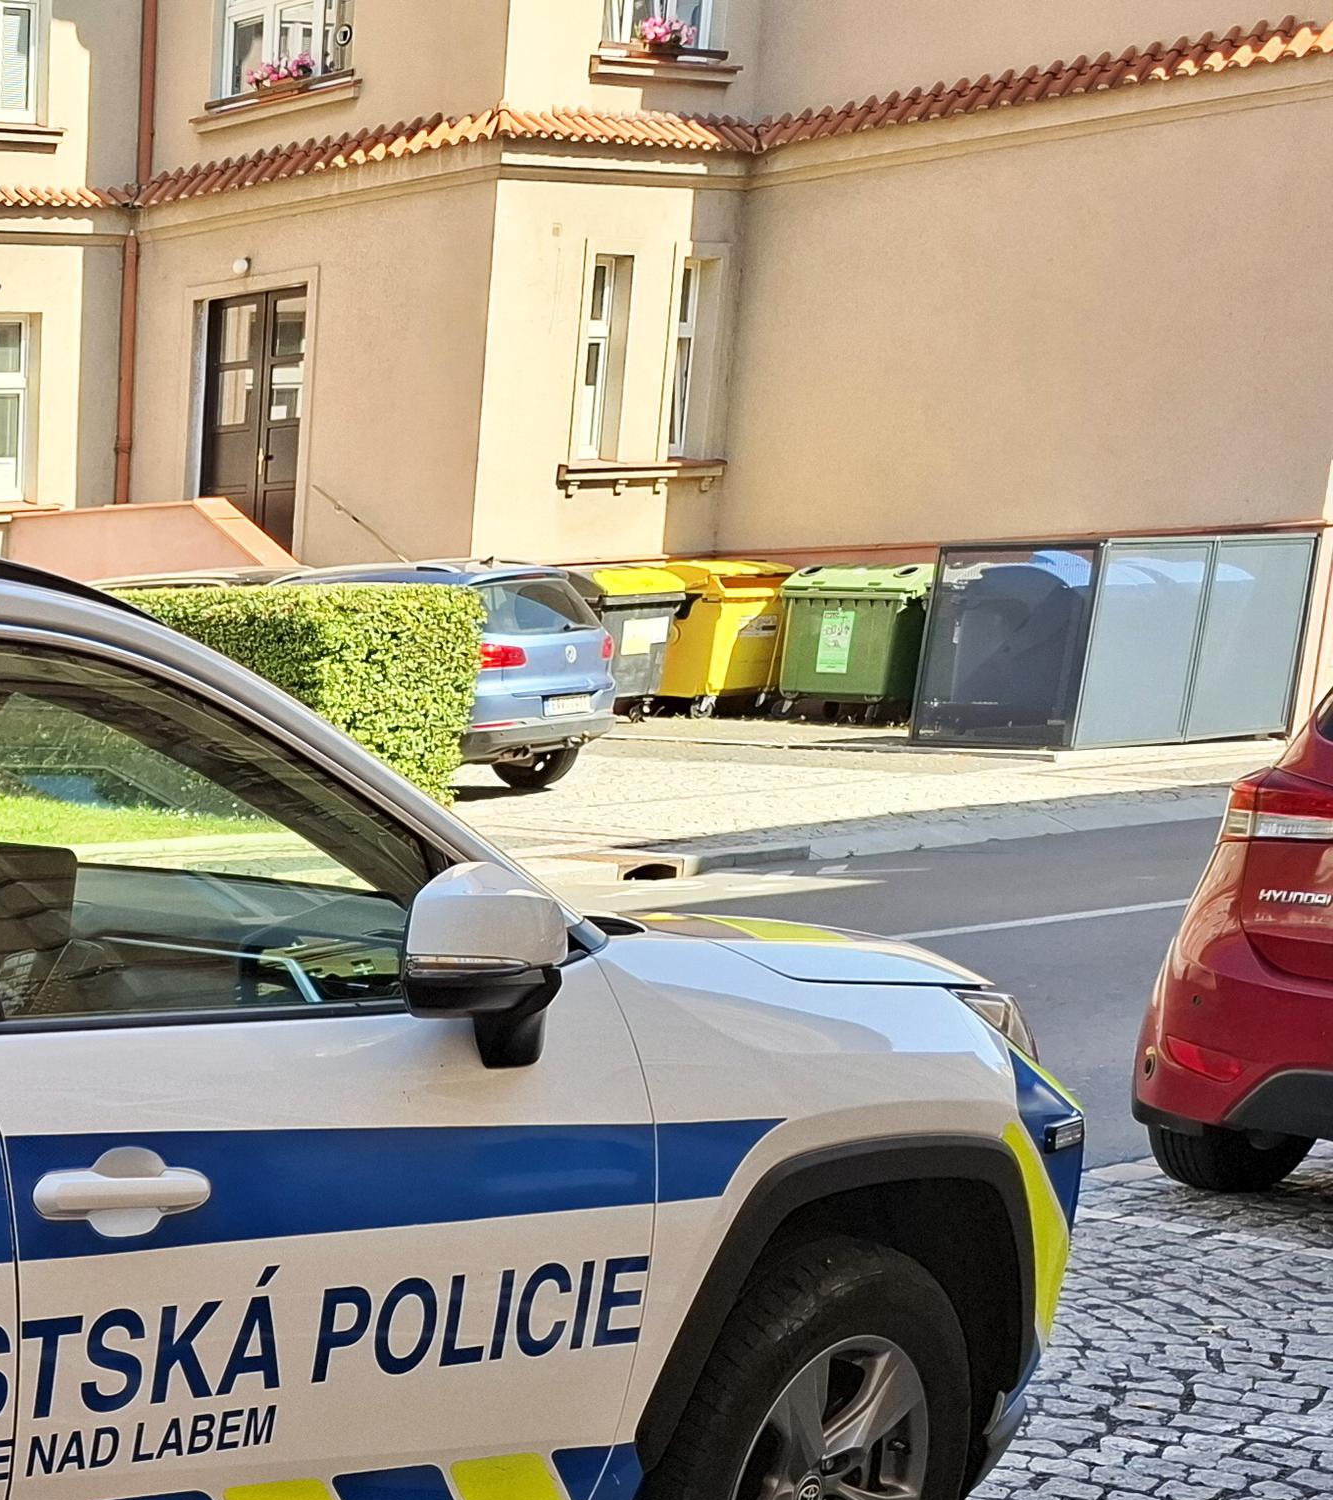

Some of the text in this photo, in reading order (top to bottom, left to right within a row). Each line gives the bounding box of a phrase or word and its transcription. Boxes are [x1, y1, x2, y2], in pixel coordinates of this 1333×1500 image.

[1258, 888, 1332, 906] HYUNDAI
[311, 1255, 651, 1384] POLICIE
[25, 1426, 120, 1477] NAD
[131, 1404, 277, 1463] LABEM
